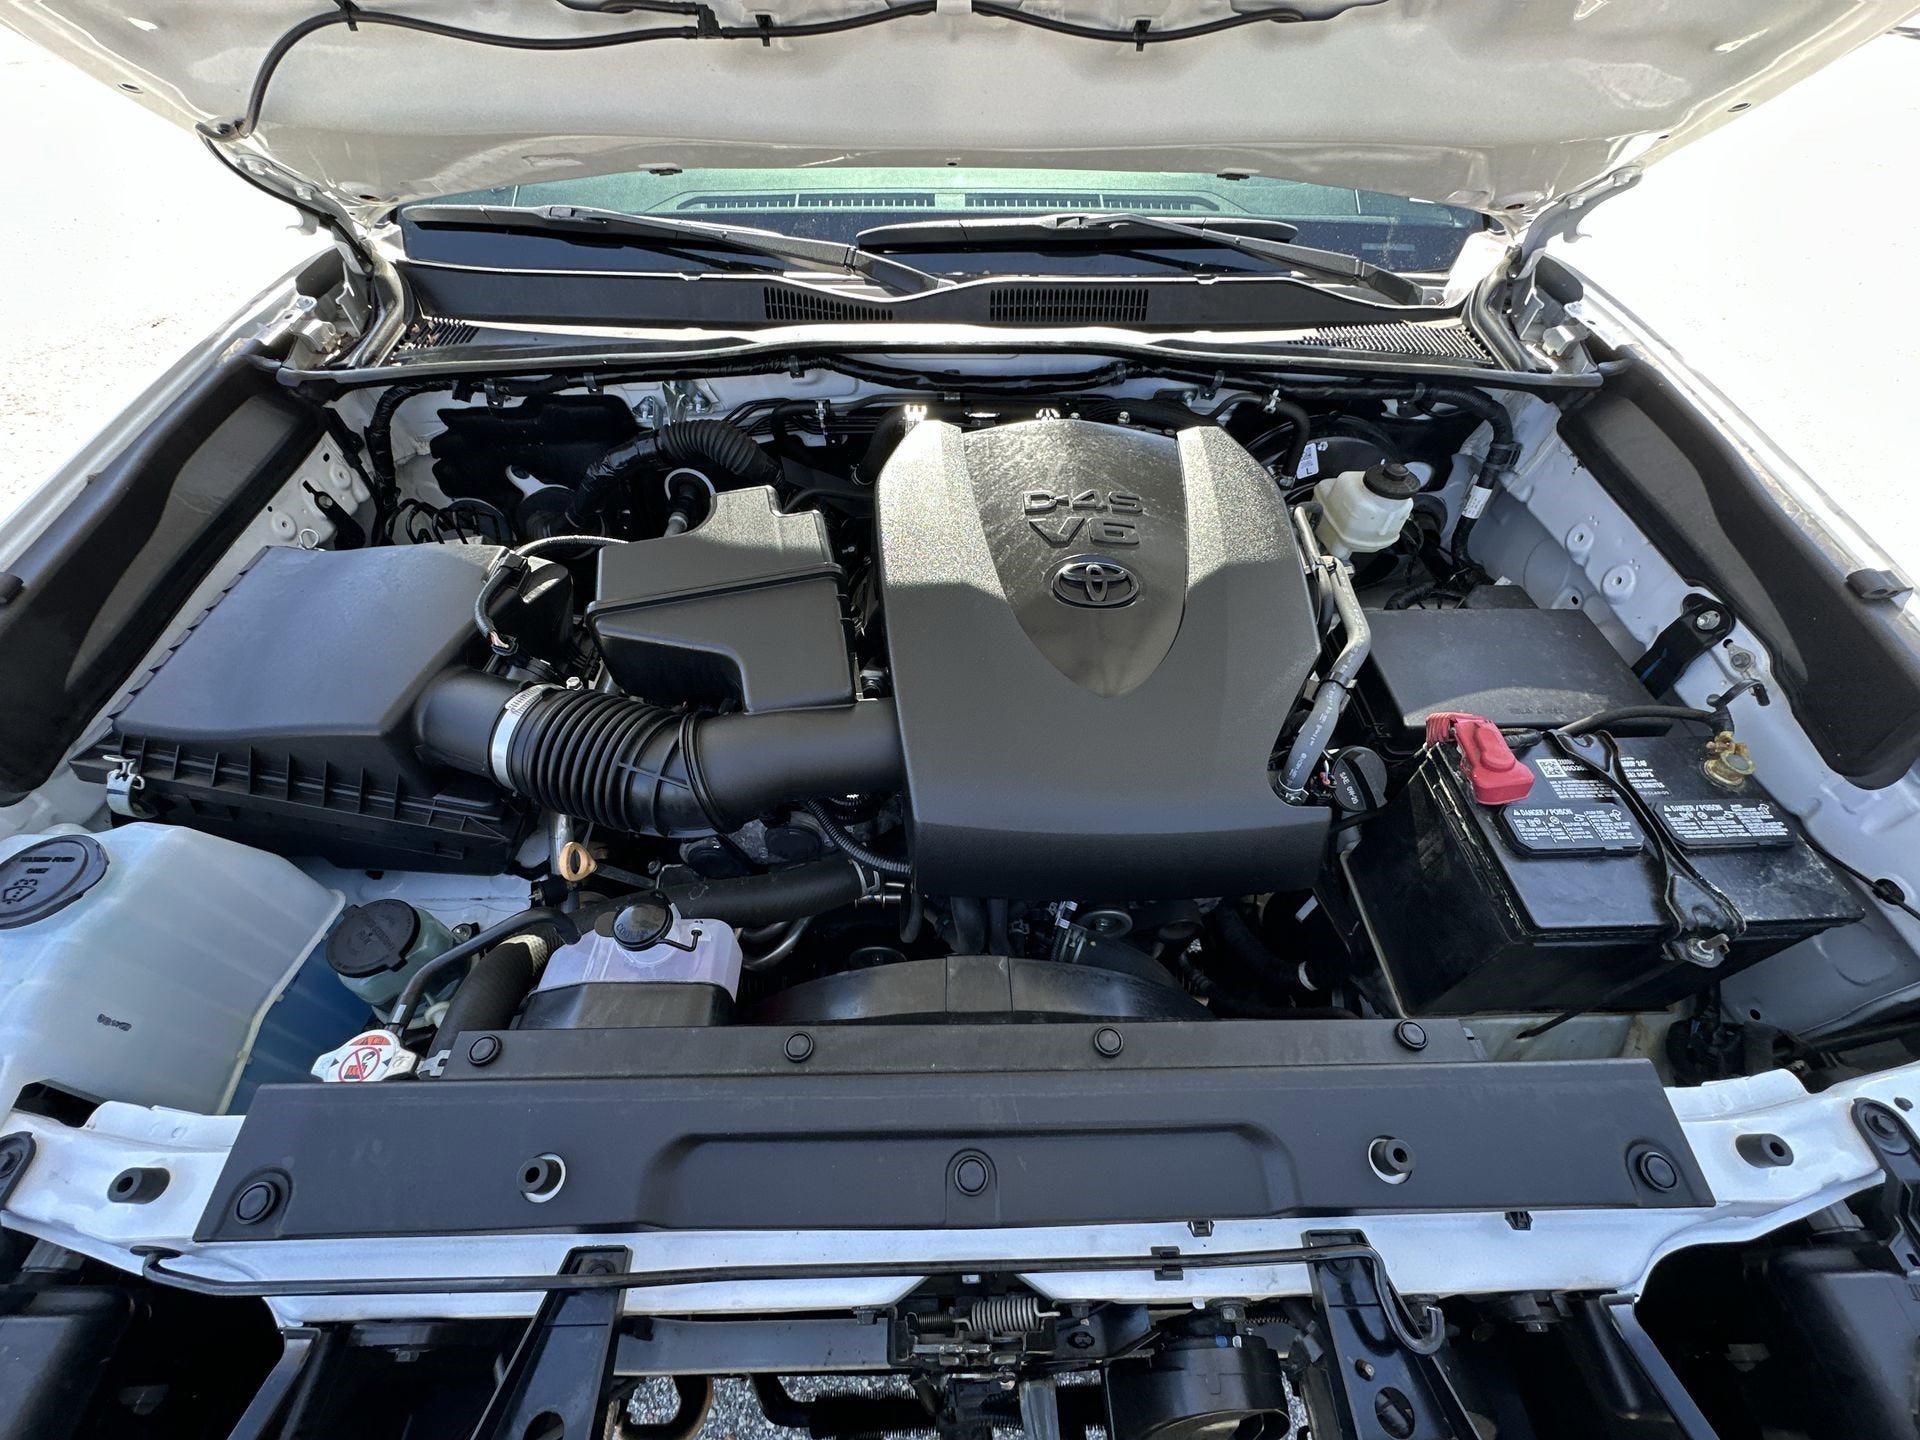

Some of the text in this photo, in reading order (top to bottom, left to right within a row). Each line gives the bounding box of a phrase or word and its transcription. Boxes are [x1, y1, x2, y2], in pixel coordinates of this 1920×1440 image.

[1023, 489, 1144, 516] D-4S
[1029, 516, 1141, 549] V6
[1339, 771, 1351, 785] SAE
[1346, 785, 1359, 805] 0W-20
[1549, 808, 1573, 816] POISON
